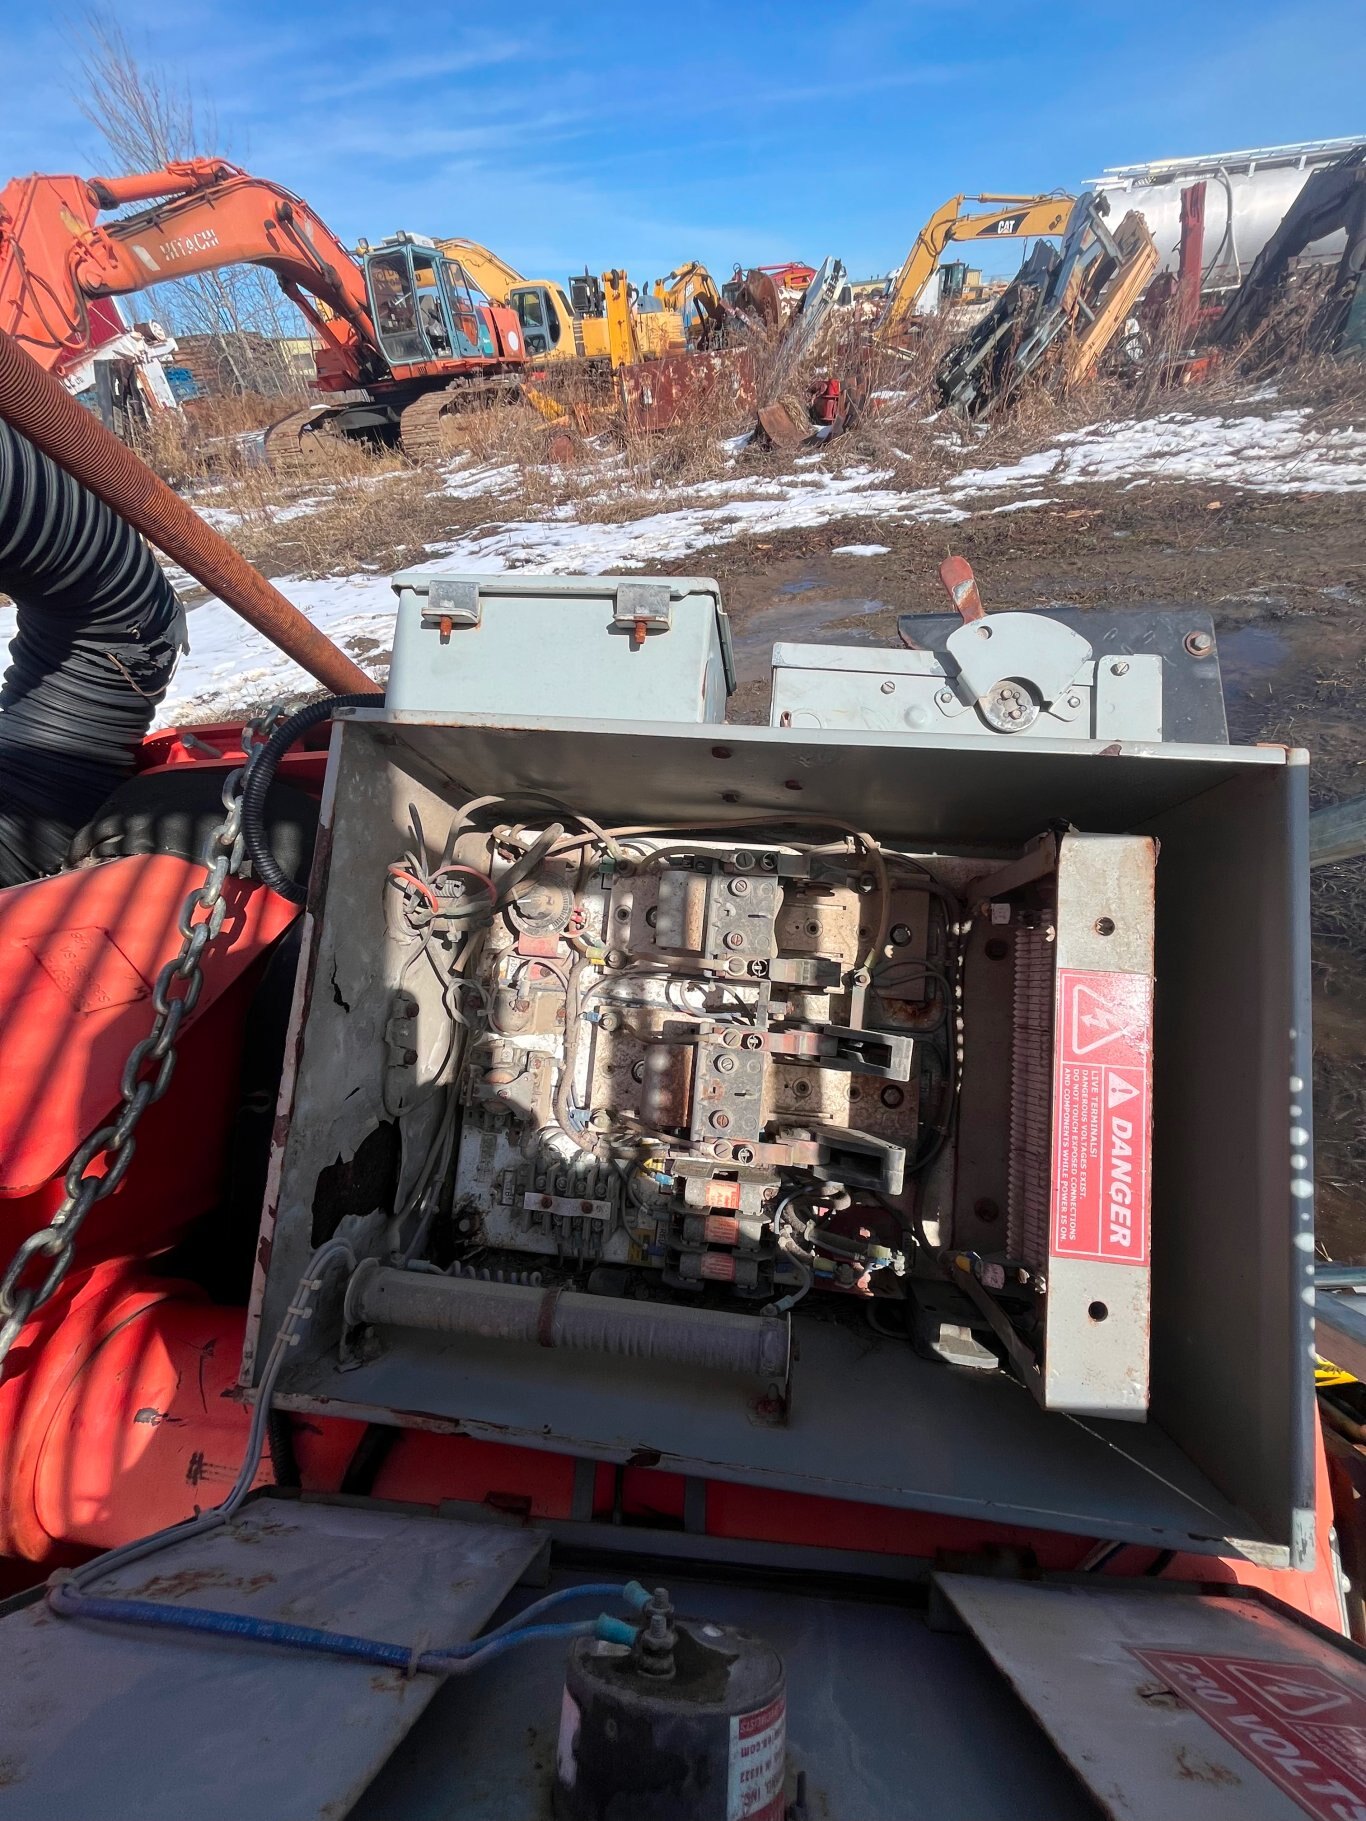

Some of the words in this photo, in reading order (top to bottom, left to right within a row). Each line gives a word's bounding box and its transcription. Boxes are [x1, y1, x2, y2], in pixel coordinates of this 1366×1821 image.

[160, 229, 220, 261] HITACHI
[997, 220, 1015, 234] CAT
[1073, 1068, 1080, 1081] DO
[1091, 1070, 1099, 1094] LIVE
[1081, 1069, 1089, 1122] DANGEROUS
[1062, 1088, 1071, 1148] COMPONENTS
[1090, 1096, 1099, 1158] TERMINALS!
[1071, 1135, 1079, 1175] EXPOSED
[1080, 1124, 1088, 1169] VOLTAGES
[1061, 1180, 1069, 1213] POWER
[1079, 1171, 1087, 1200] EXIST.
[1109, 1115, 1133, 1247] DANGER
[1060, 1215, 1068, 1225] IS
[1069, 1176, 1078, 1241] CONNECTIONS
[1059, 1226, 1067, 1242] ON.
[1160, 1659, 1238, 1704] 230
